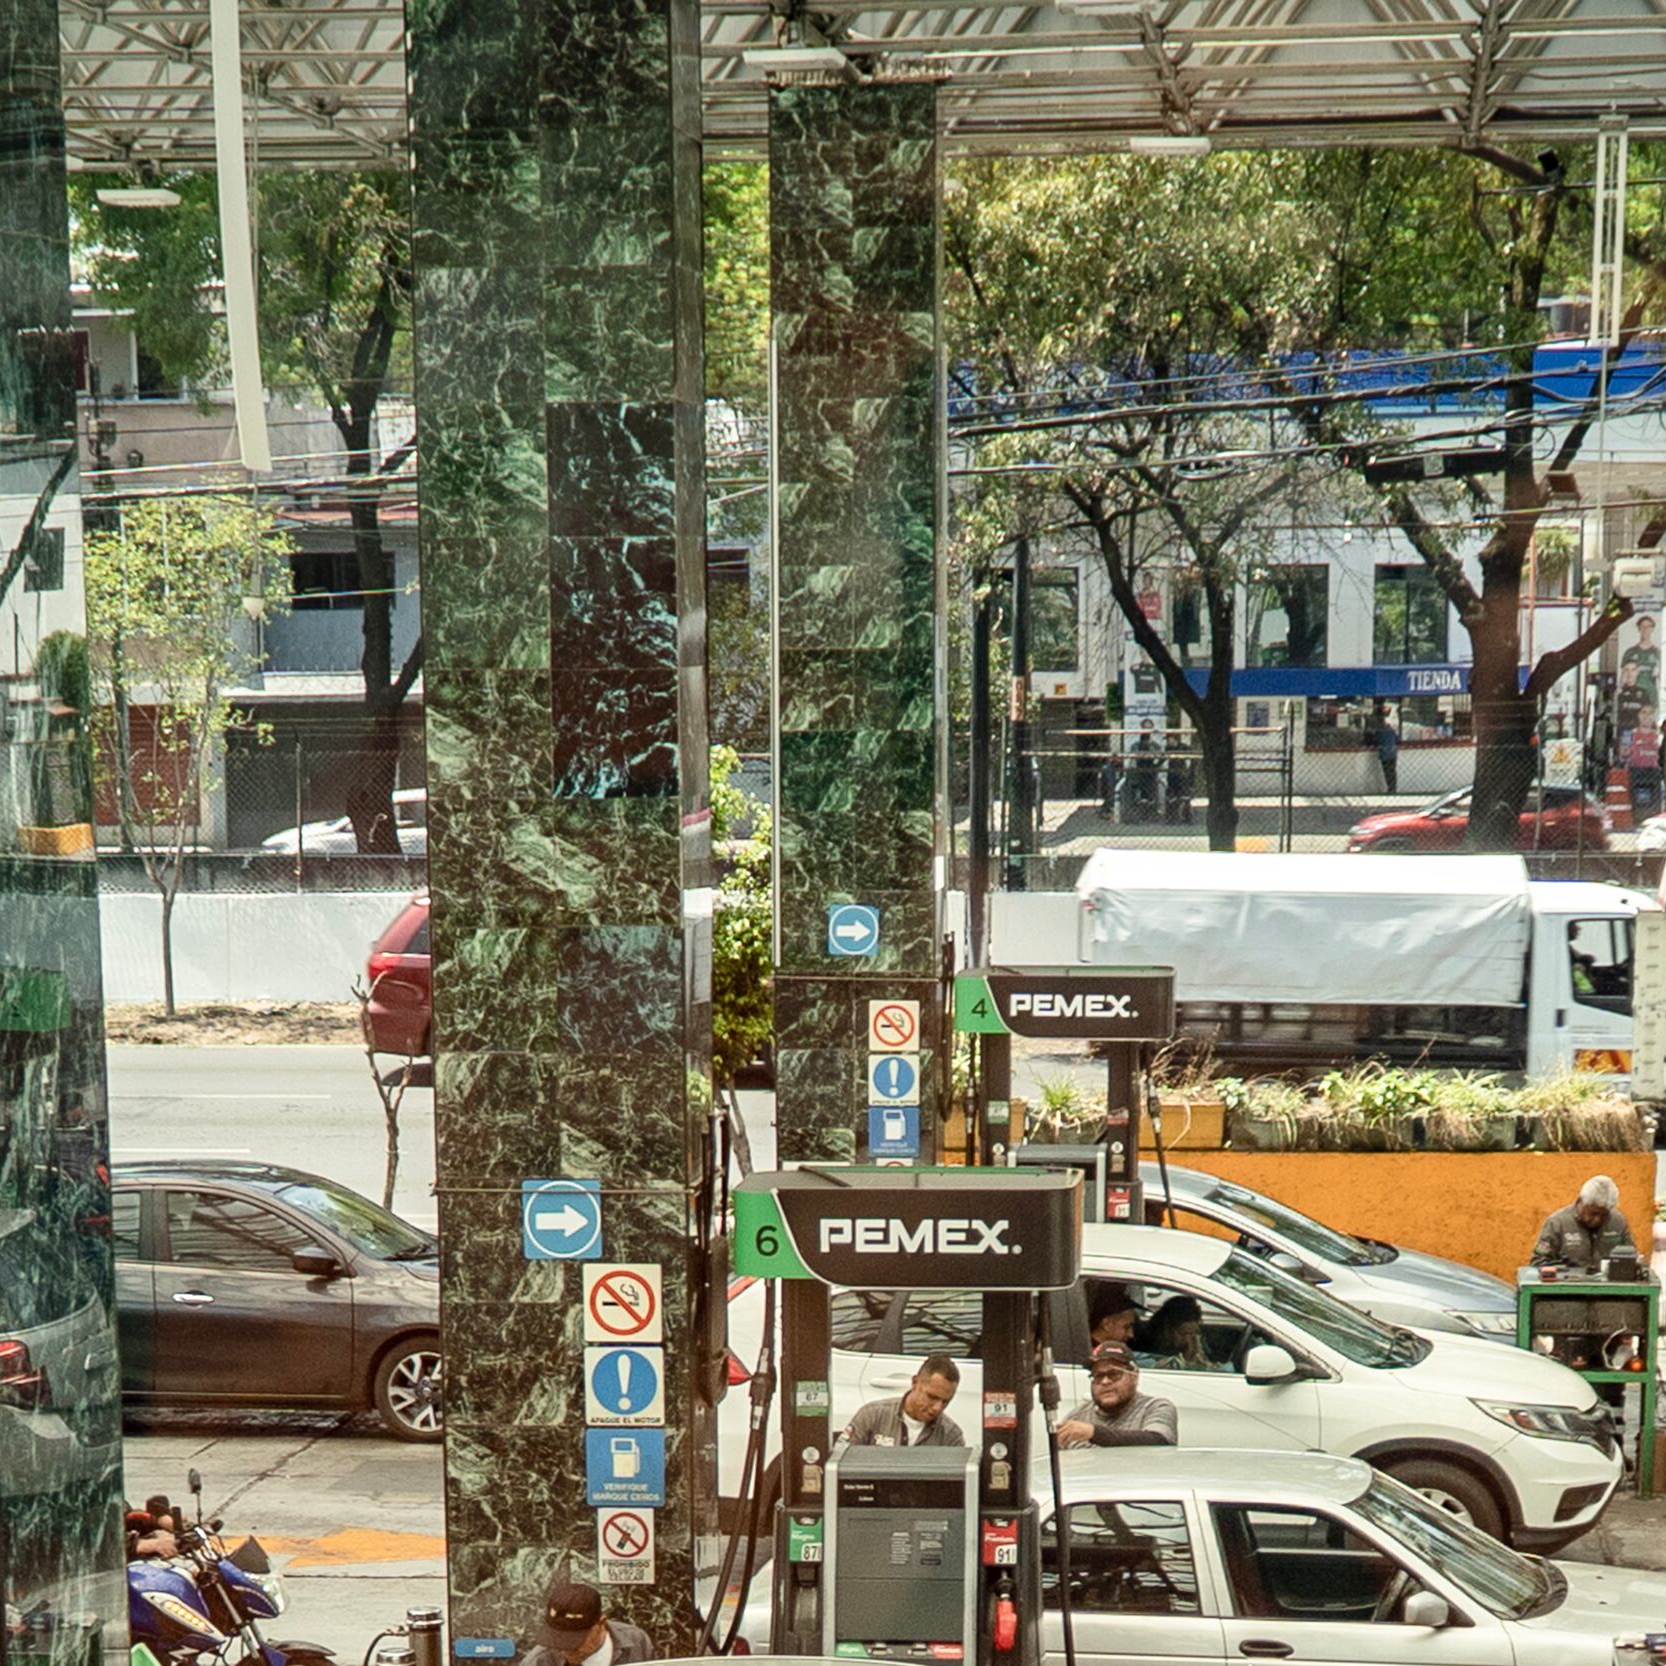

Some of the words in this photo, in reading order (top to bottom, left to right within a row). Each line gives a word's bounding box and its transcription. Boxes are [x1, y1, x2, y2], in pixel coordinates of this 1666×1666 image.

[1407, 669, 1462, 691] TIENDA
[971, 998, 987, 1018] 4
[1009, 993, 1131, 1018] PEMEX
[755, 1225, 779, 1256] 6
[819, 1218, 1009, 1254] PEMEX
[994, 1402, 1008, 1413] 91
[803, 1545, 818, 1561] 87
[997, 1547, 1012, 1563] 91
